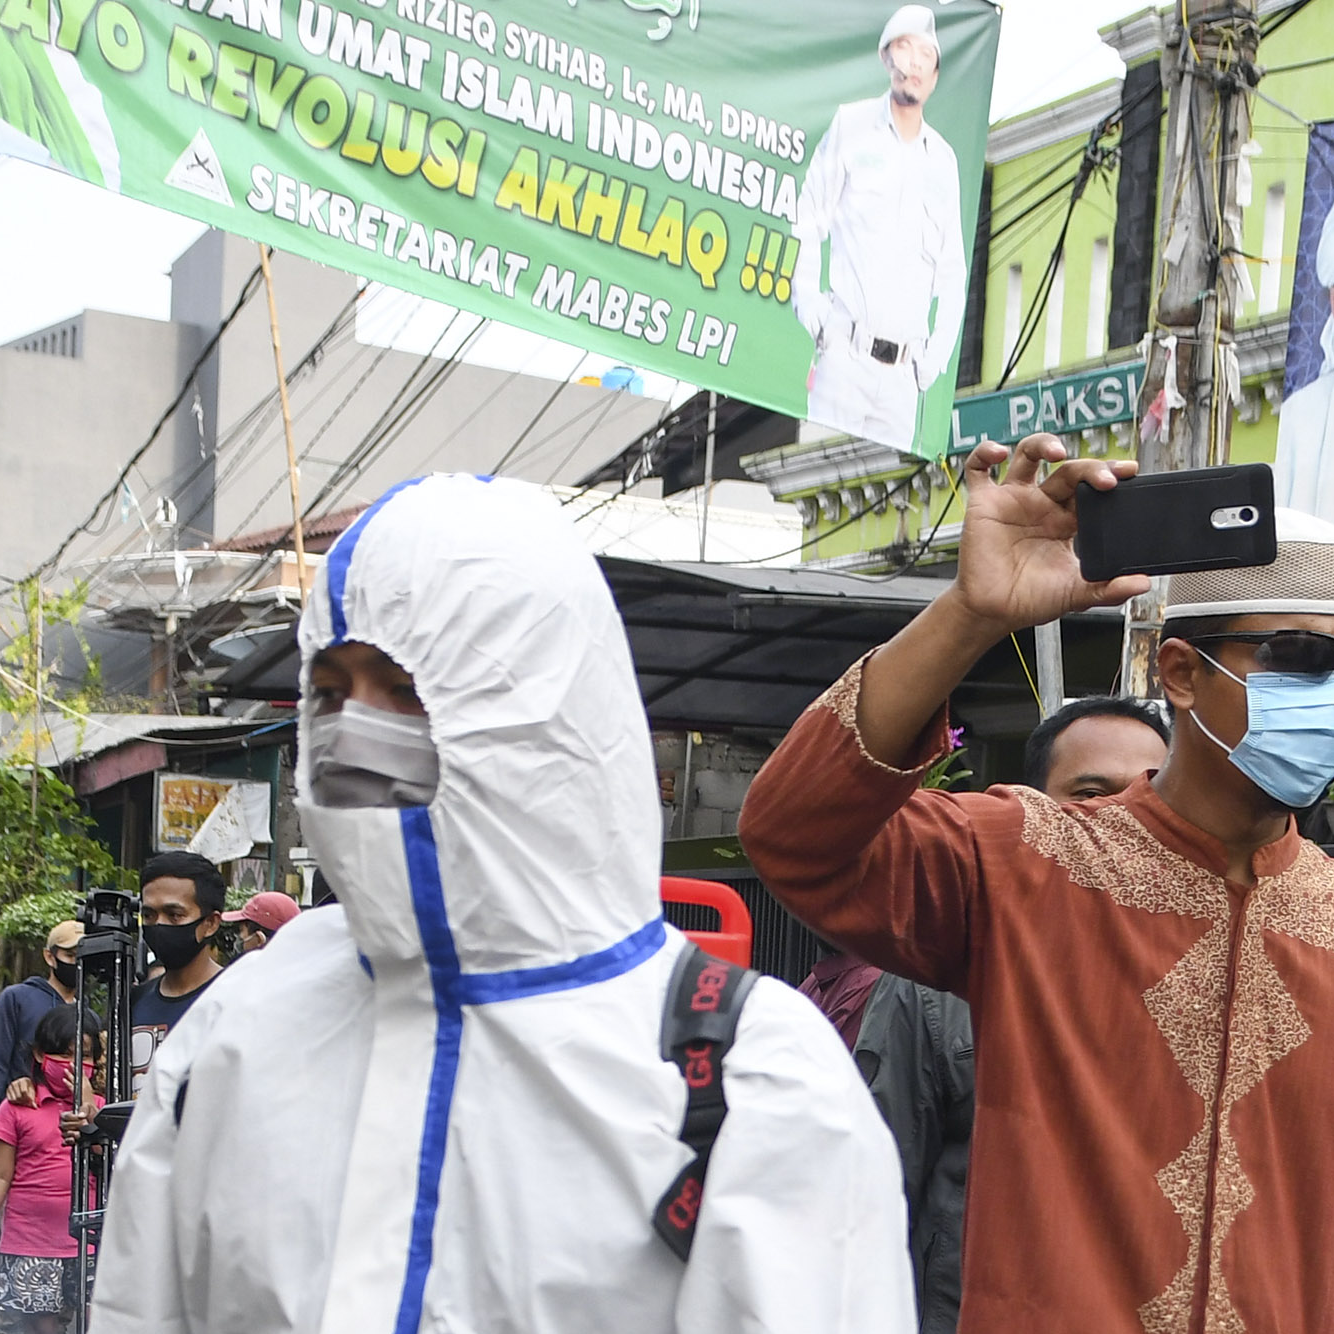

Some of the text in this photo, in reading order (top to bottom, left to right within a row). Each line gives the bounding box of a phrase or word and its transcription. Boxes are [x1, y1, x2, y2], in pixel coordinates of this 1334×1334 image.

[166, 24, 485, 198] REVOLUSI
[494, 145, 728, 288] AKHLAQ
[298, 0, 431, 91] UMAT
[441, 50, 574, 143] ISLAM
[586, 101, 798, 224] INDONESIA
[504, 22, 614, 99] SYIHAB,
[621, 66, 657, 115] Lc,
[663, 81, 713, 136] MA,
[721, 103, 805, 164] DPMSS
[245, 163, 738, 366] SEKRETARIAT MABES LPI
[1008, 373, 1137, 437] PAKSI
